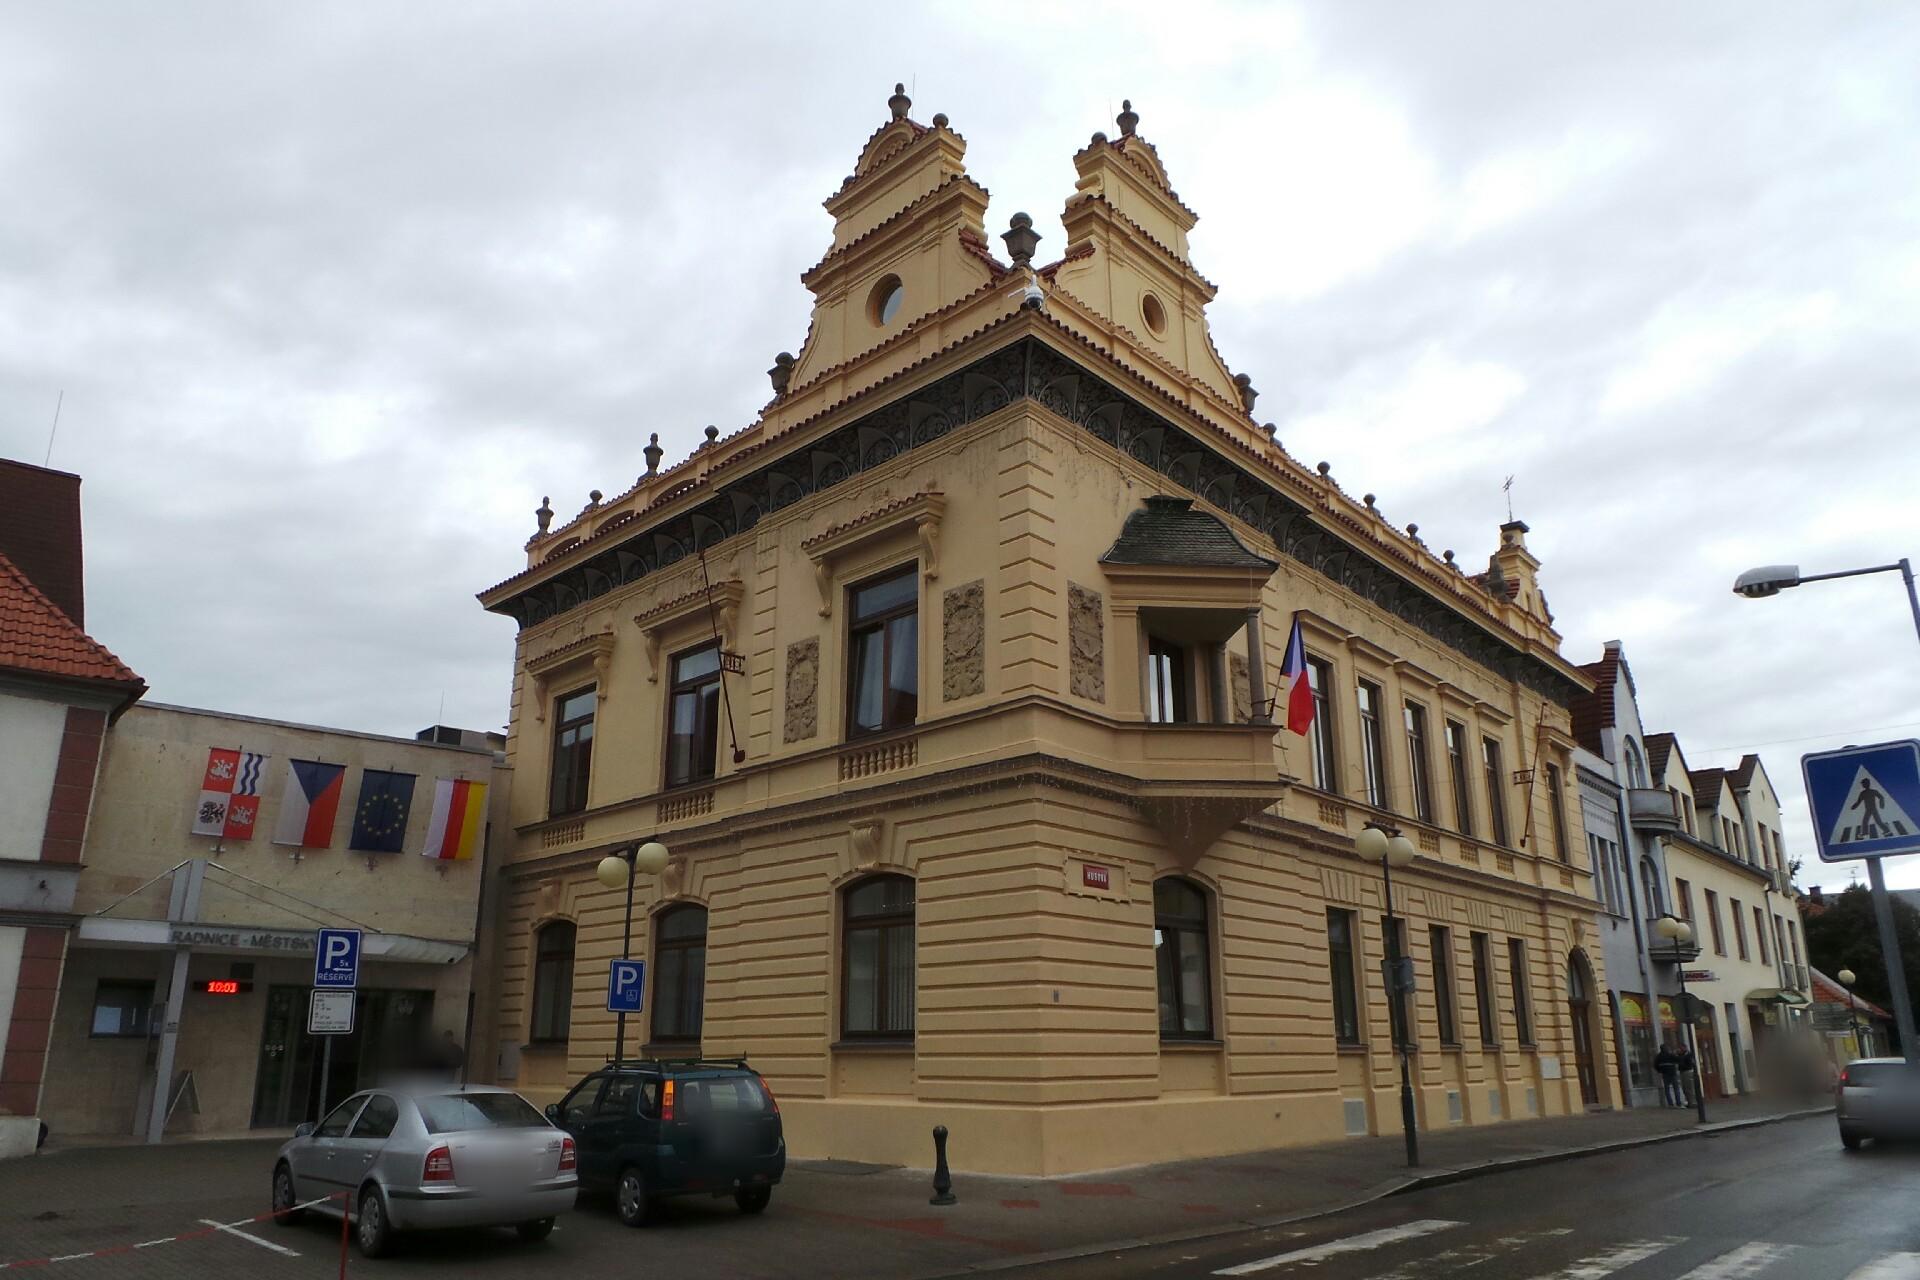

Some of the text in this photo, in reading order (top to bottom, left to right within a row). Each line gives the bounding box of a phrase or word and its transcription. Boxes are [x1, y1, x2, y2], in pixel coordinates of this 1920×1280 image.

[172, 930, 241, 947] RADNICE
[325, 936, 351, 969] P
[208, 981, 238, 993] 10:01
[616, 966, 638, 995] P
